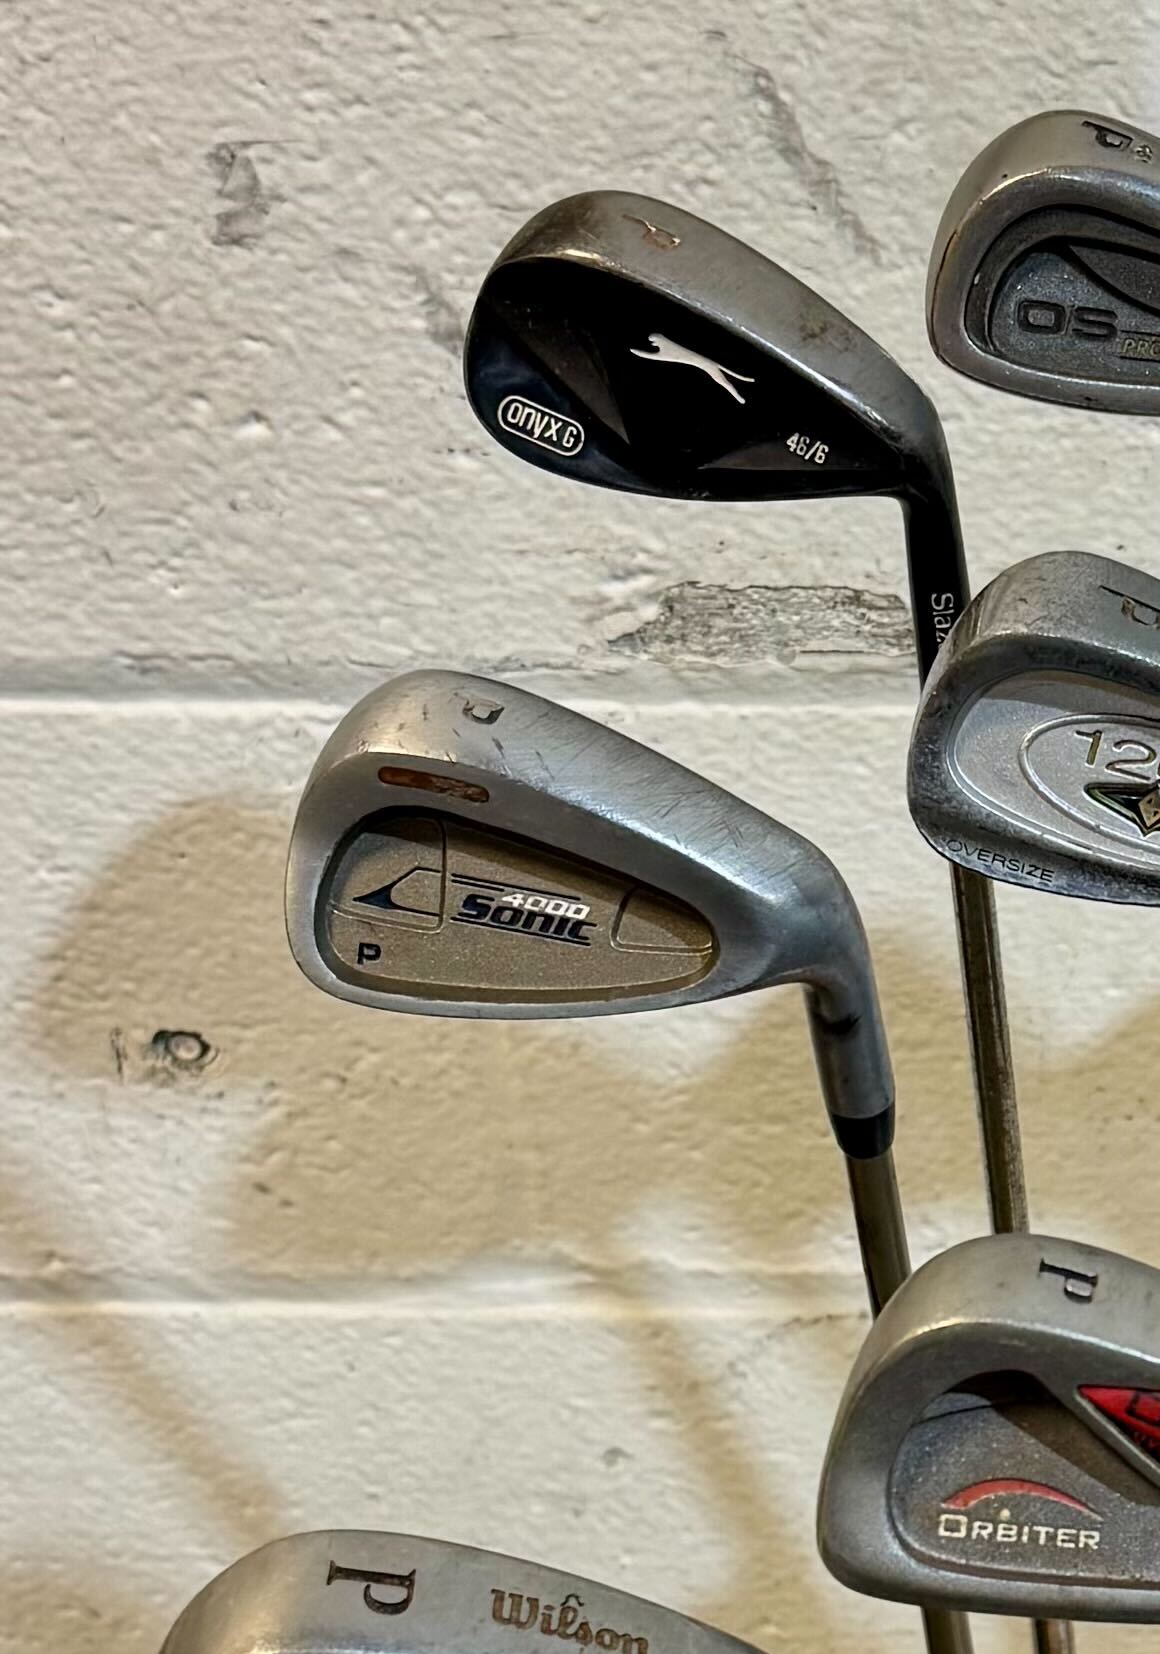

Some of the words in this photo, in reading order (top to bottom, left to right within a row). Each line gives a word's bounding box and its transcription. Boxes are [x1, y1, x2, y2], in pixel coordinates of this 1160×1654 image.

[562, 425, 577, 447] G
[786, 432, 828, 465] 46/6
[945, 839, 1056, 884] OVERSIZE
[500, 891, 590, 921] 4000
[358, 942, 381, 965] P
[1039, 1258, 1098, 1301] P
[327, 1560, 417, 1616] P
